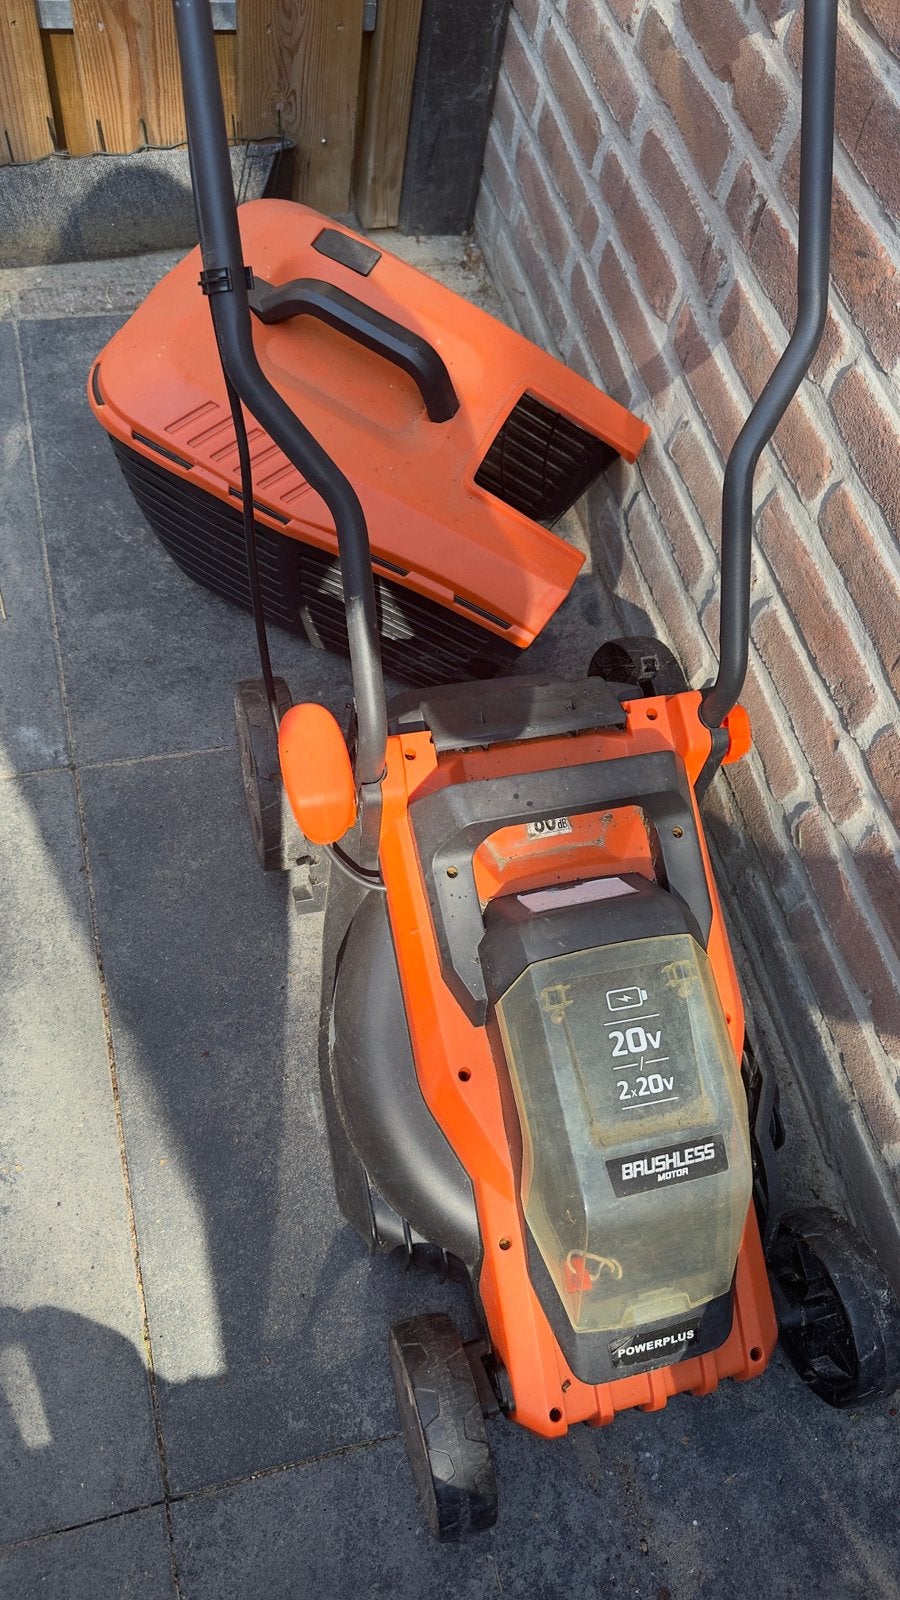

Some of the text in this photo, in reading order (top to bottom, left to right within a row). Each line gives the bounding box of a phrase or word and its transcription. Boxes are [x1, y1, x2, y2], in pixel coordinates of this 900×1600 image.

[557, 817, 568, 829] dB
[621, 1143, 715, 1180] BRUSHLESS
[657, 1167, 689, 1182] MOTOR
[617, 1330, 695, 1358] POWERPLUS
